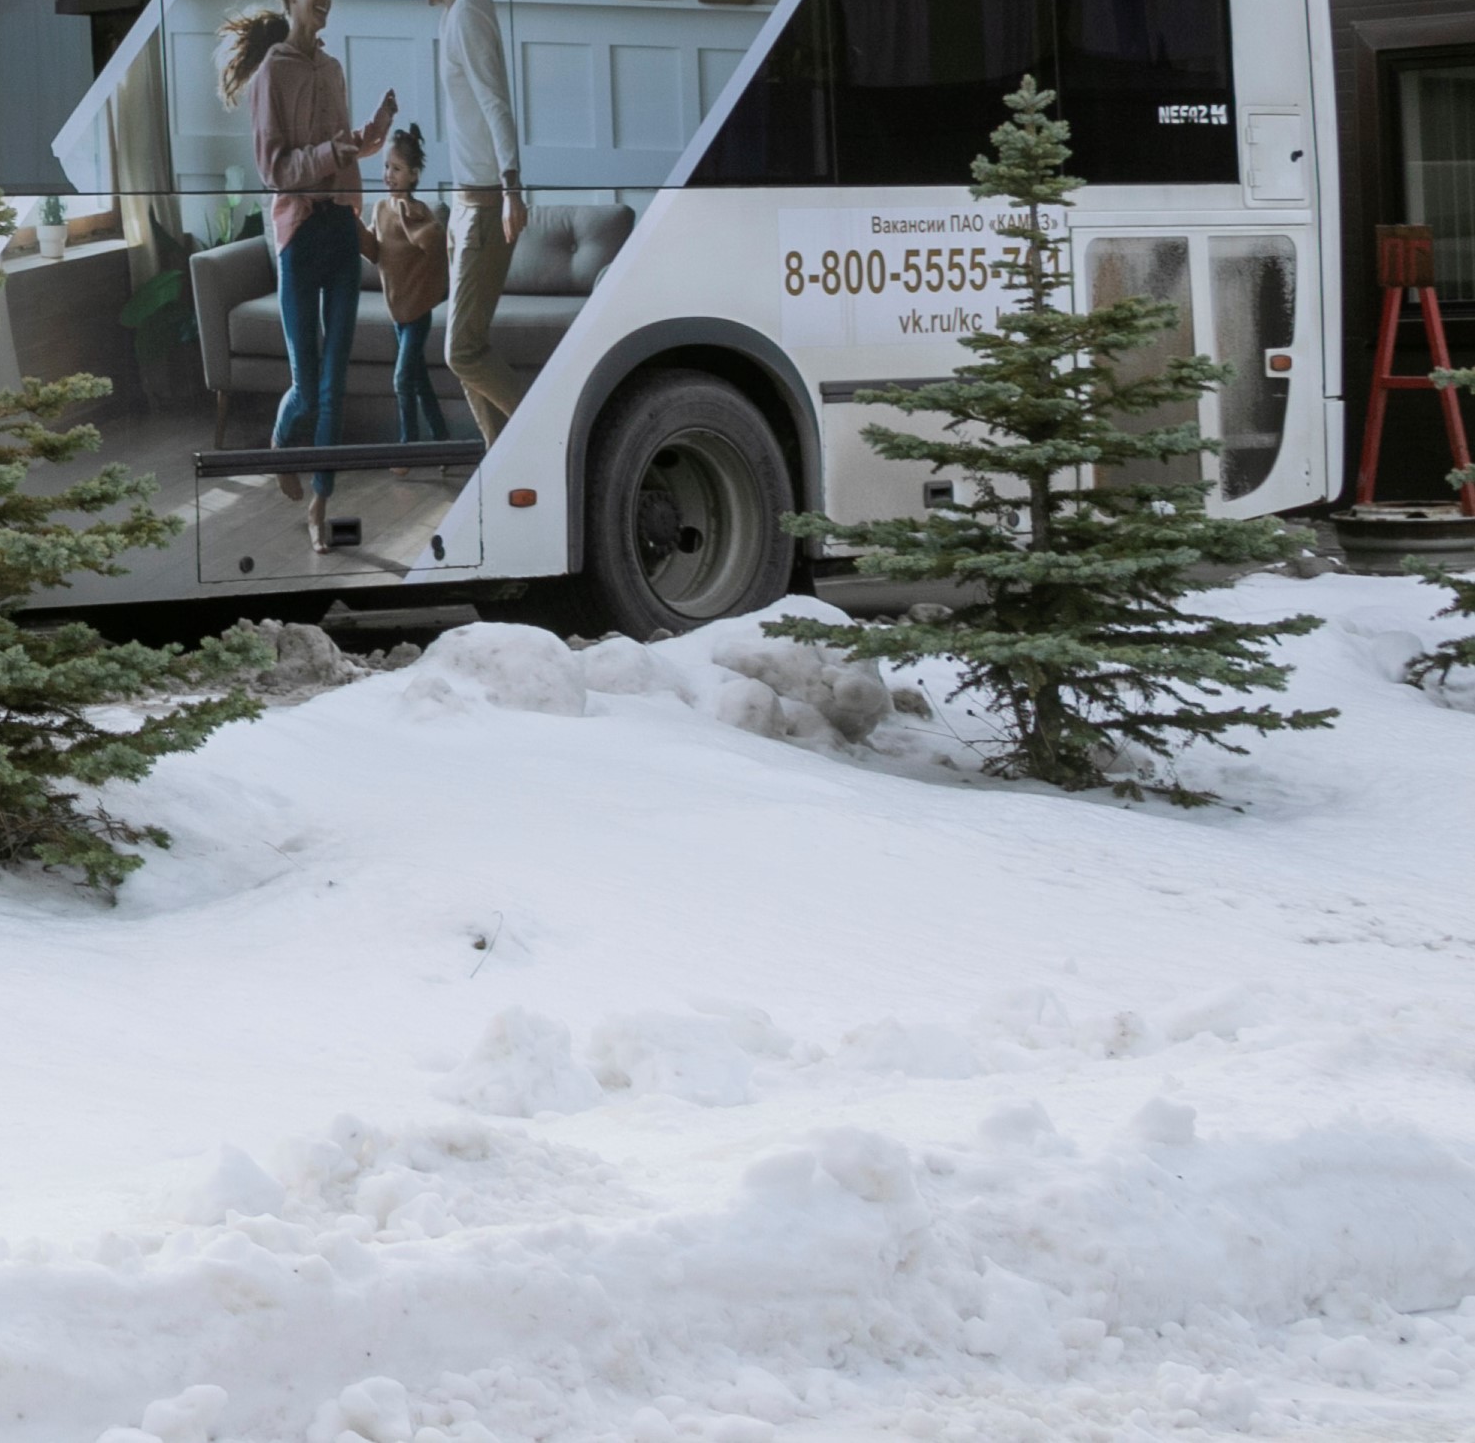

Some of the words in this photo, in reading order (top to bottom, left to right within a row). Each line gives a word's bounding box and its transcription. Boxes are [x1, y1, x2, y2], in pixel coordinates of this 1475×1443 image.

[871, 215, 945, 234] Вакансии
[950, 214, 984, 232] ПАО
[989, 212, 1058, 232] «КАМЗ»
